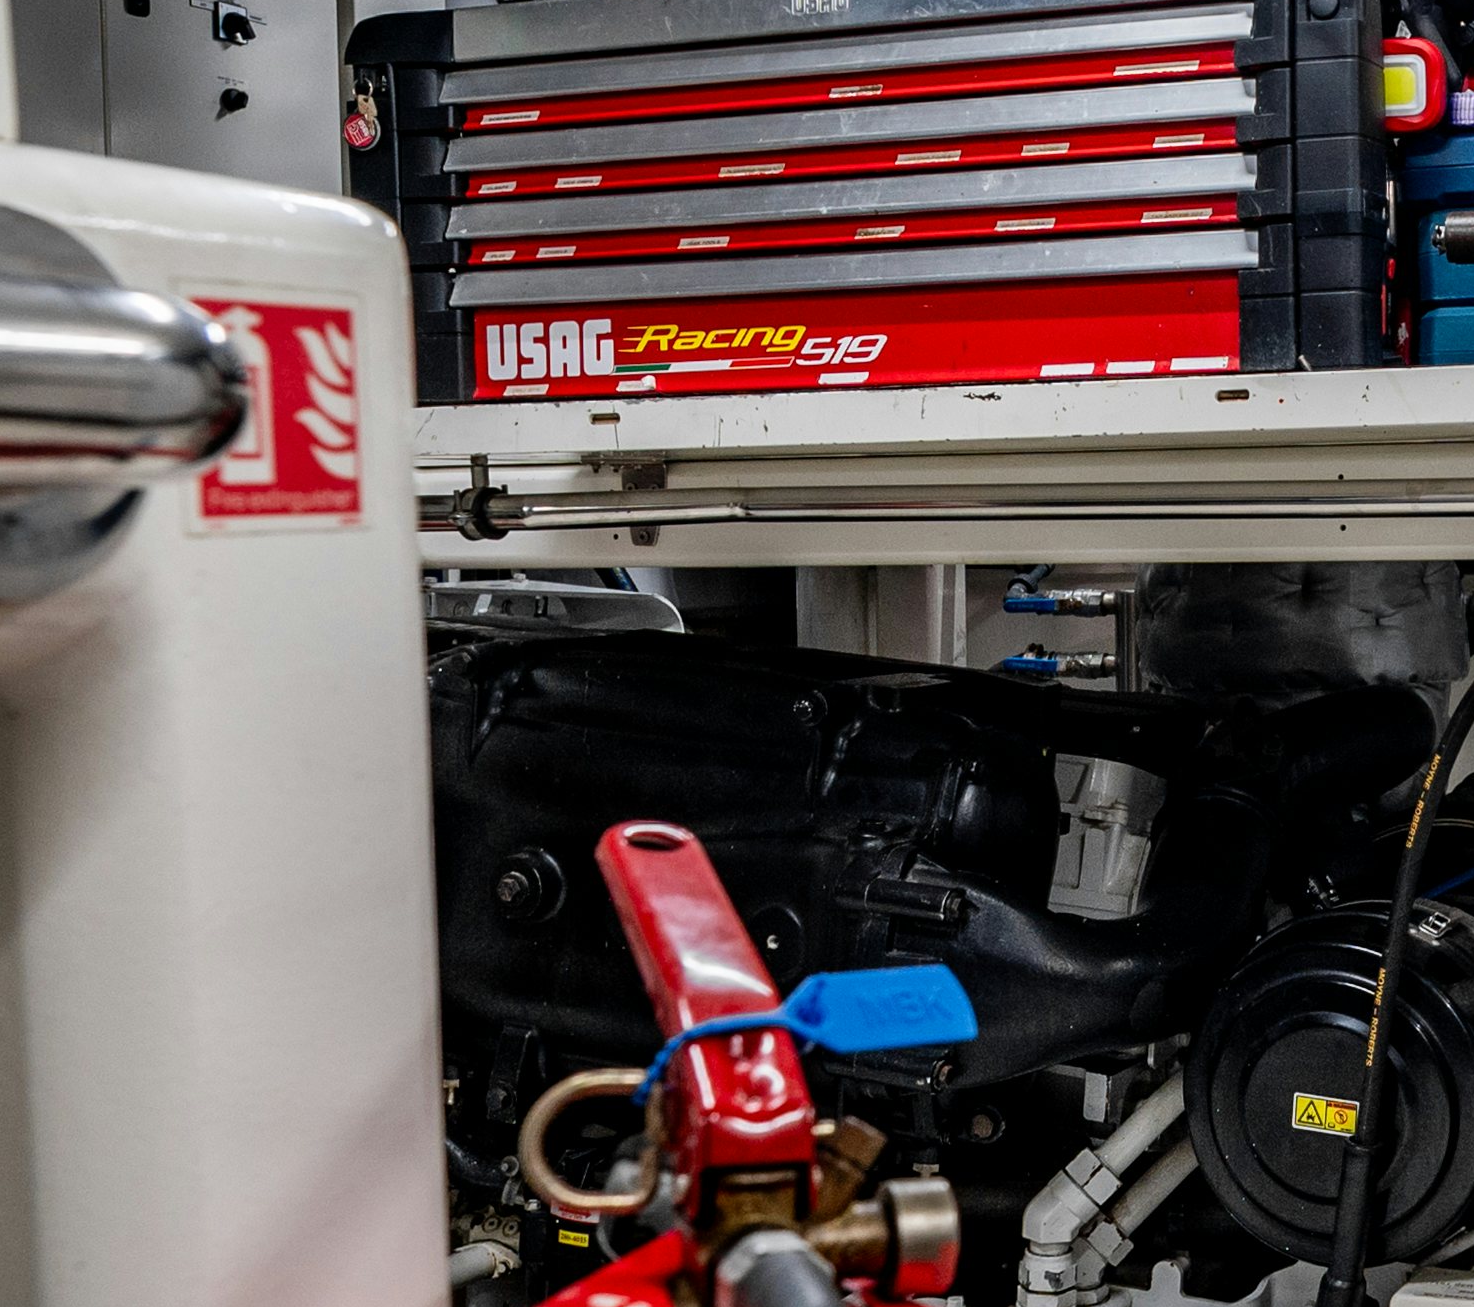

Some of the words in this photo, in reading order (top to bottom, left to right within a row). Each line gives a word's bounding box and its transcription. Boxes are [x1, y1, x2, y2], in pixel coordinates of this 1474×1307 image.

[486, 319, 615, 380] USAG
[622, 324, 807, 354] Racing
[796, 333, 887, 366] 519
[1423, 754, 1442, 791] MOYNE
[1406, 797, 1425, 848] ROBERTS
[1375, 967, 1386, 1006] MOYNE
[1365, 1016, 1380, 1067] ROBERTS
